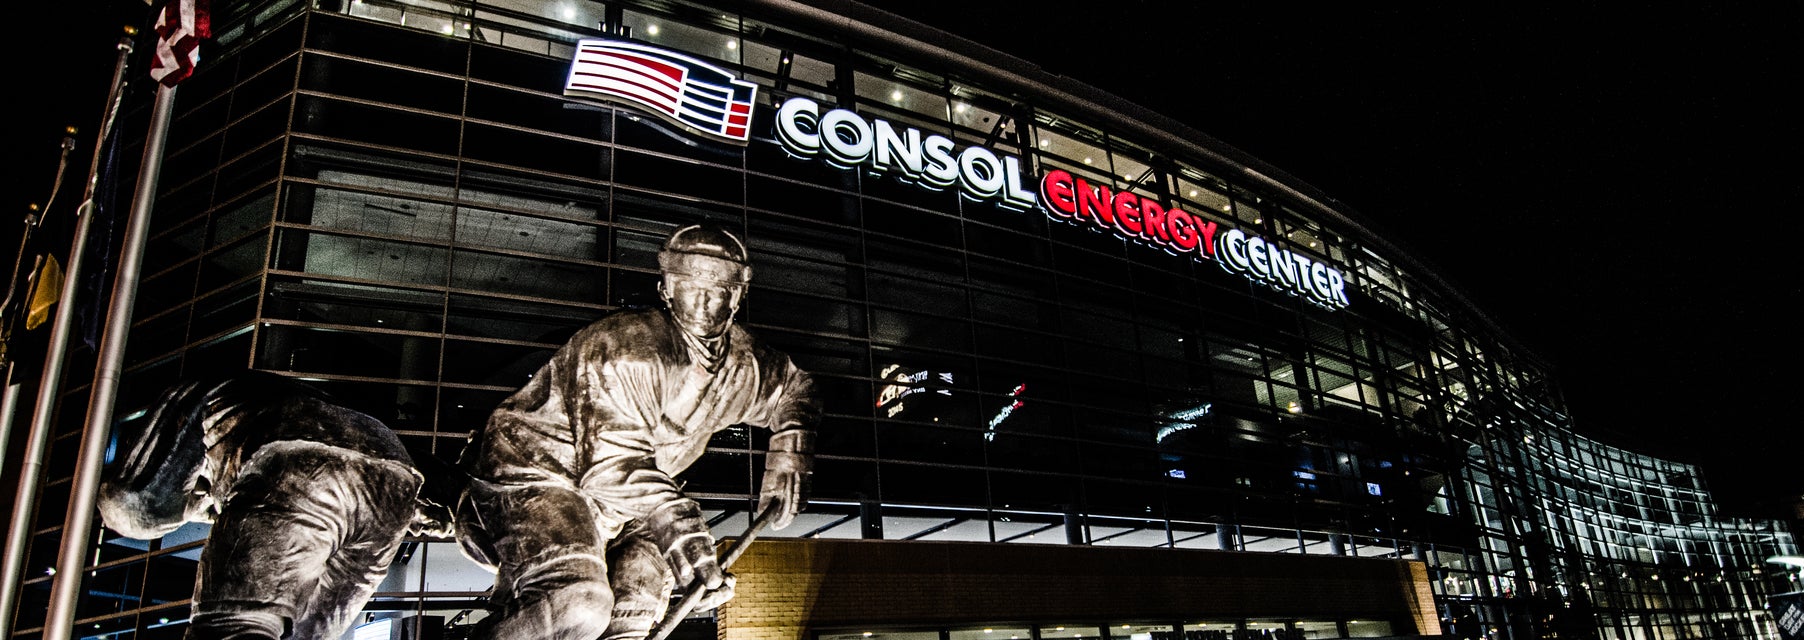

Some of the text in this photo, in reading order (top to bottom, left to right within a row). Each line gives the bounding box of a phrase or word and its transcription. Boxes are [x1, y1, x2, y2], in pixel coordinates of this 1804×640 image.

[775, 97, 1349, 306] CONSOL ENERGY CENTER
